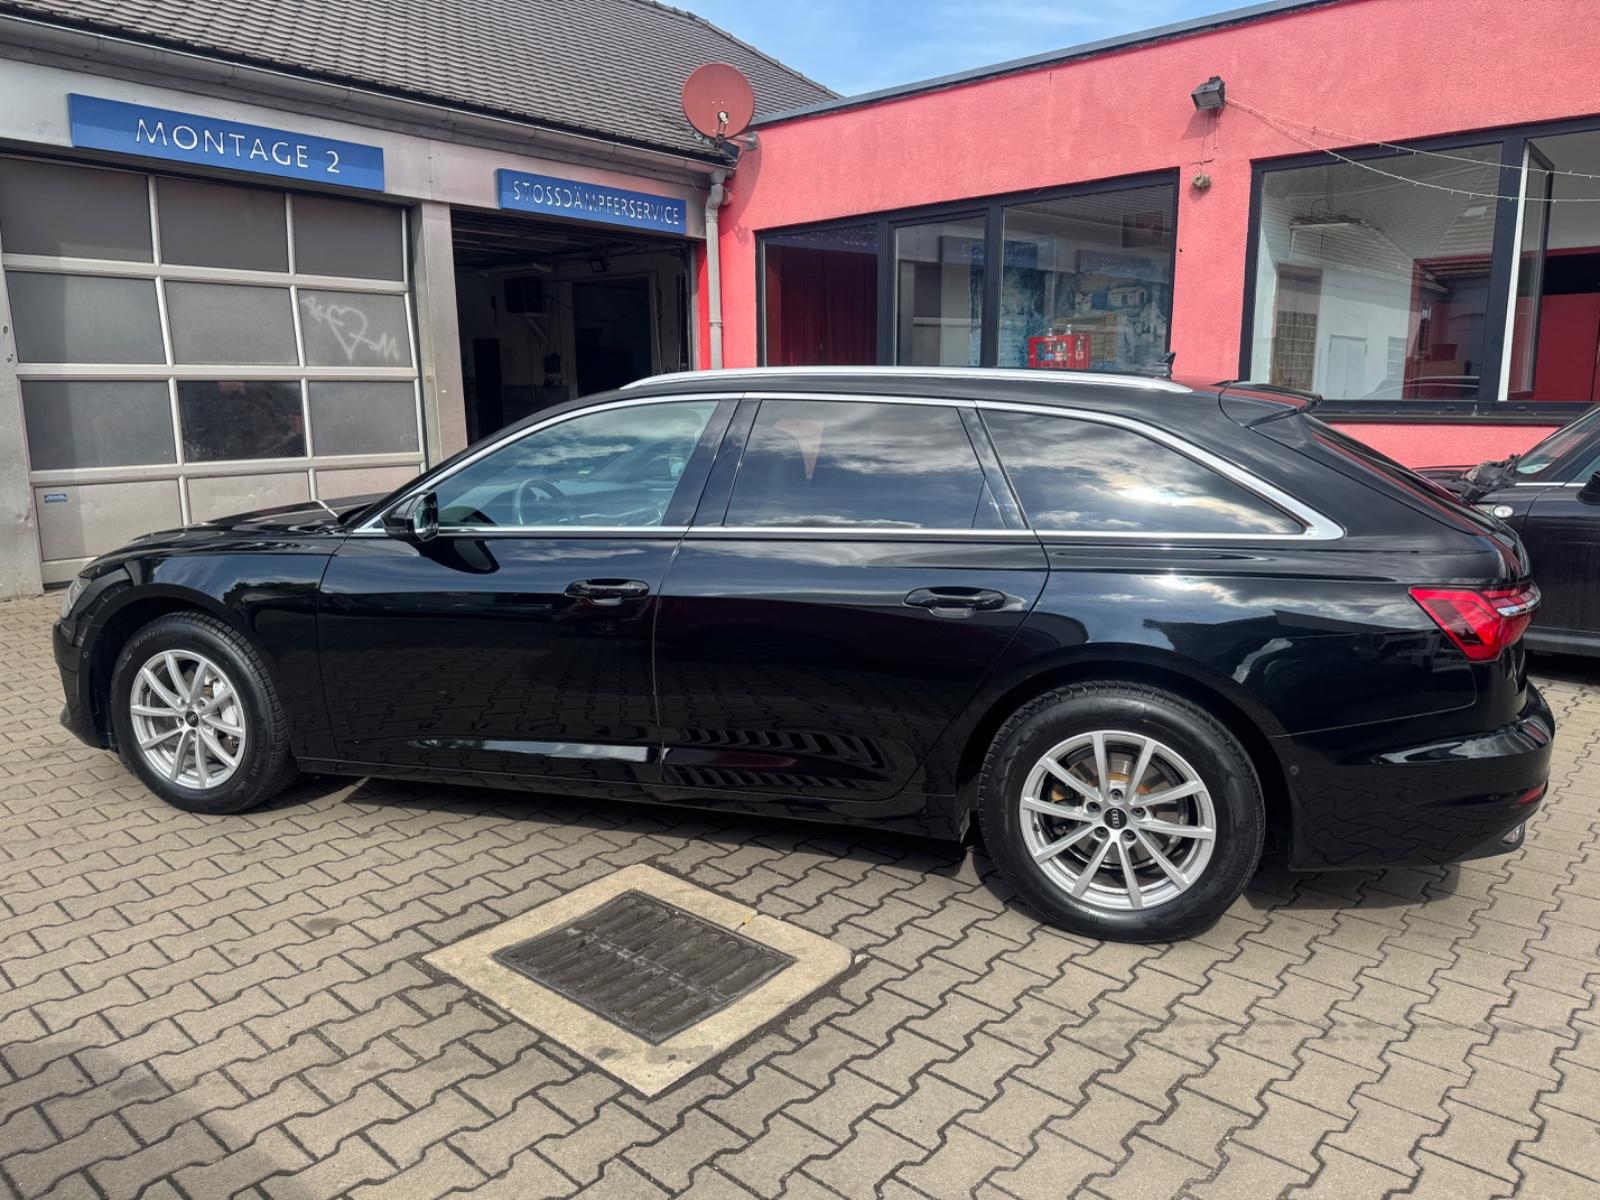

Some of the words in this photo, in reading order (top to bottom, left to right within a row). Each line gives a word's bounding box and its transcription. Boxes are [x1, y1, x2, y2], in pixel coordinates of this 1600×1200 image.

[136, 118, 309, 169] MONTAGE
[325, 150, 341, 174] 2
[513, 180, 679, 225] STOSSDÄMPFERSERVICE
